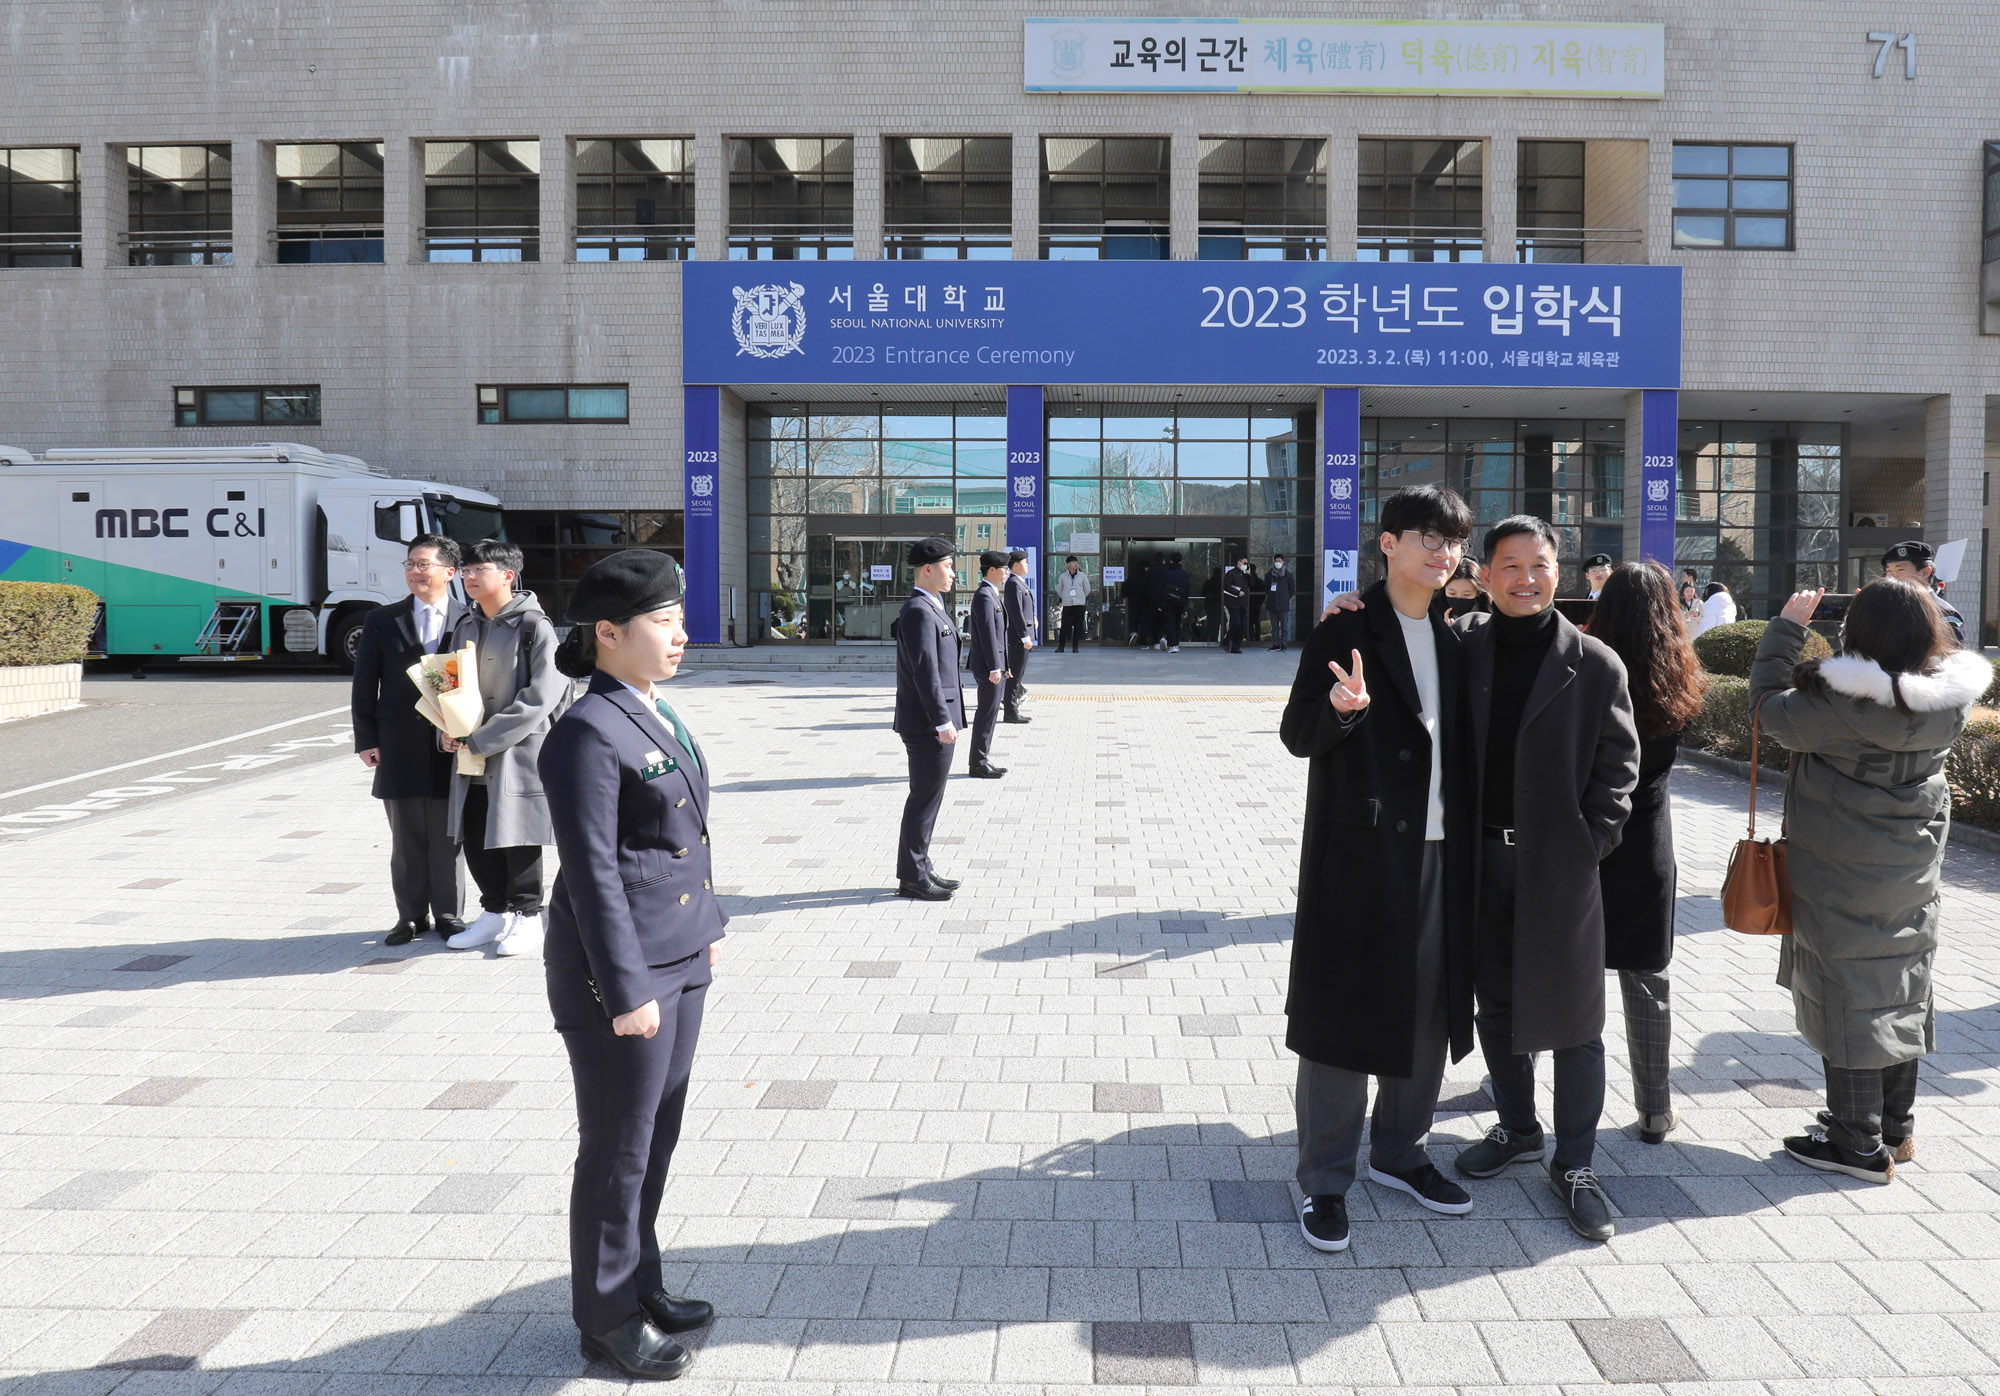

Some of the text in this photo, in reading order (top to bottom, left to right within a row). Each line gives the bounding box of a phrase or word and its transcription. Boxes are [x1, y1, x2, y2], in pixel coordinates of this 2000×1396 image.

[1110, 37, 1186, 72] 교육의
[1197, 37, 1248, 72] 근간
[1867, 32, 1916, 79] 71
[1200, 283, 1623, 337] 2023 학년도 입학식
[770, 322, 784, 330] LUX
[830, 318, 1005, 329] SEOUL NATIONAL UNIVERSITY
[755, 330, 768, 338] TAS
[770, 330, 785, 338] MEA
[832, 346, 1076, 367] 2023 Entrance Ceremony
[1501, 350, 1574, 367] 서울대학교
[1577, 351, 1620, 368] 체육관
[687, 451, 718, 463] 2023
[1010, 451, 1040, 464] 2023
[1326, 454, 1357, 466] 2023
[1644, 455, 1674, 468] 2023
[95, 508, 265, 539] MBC C&I
